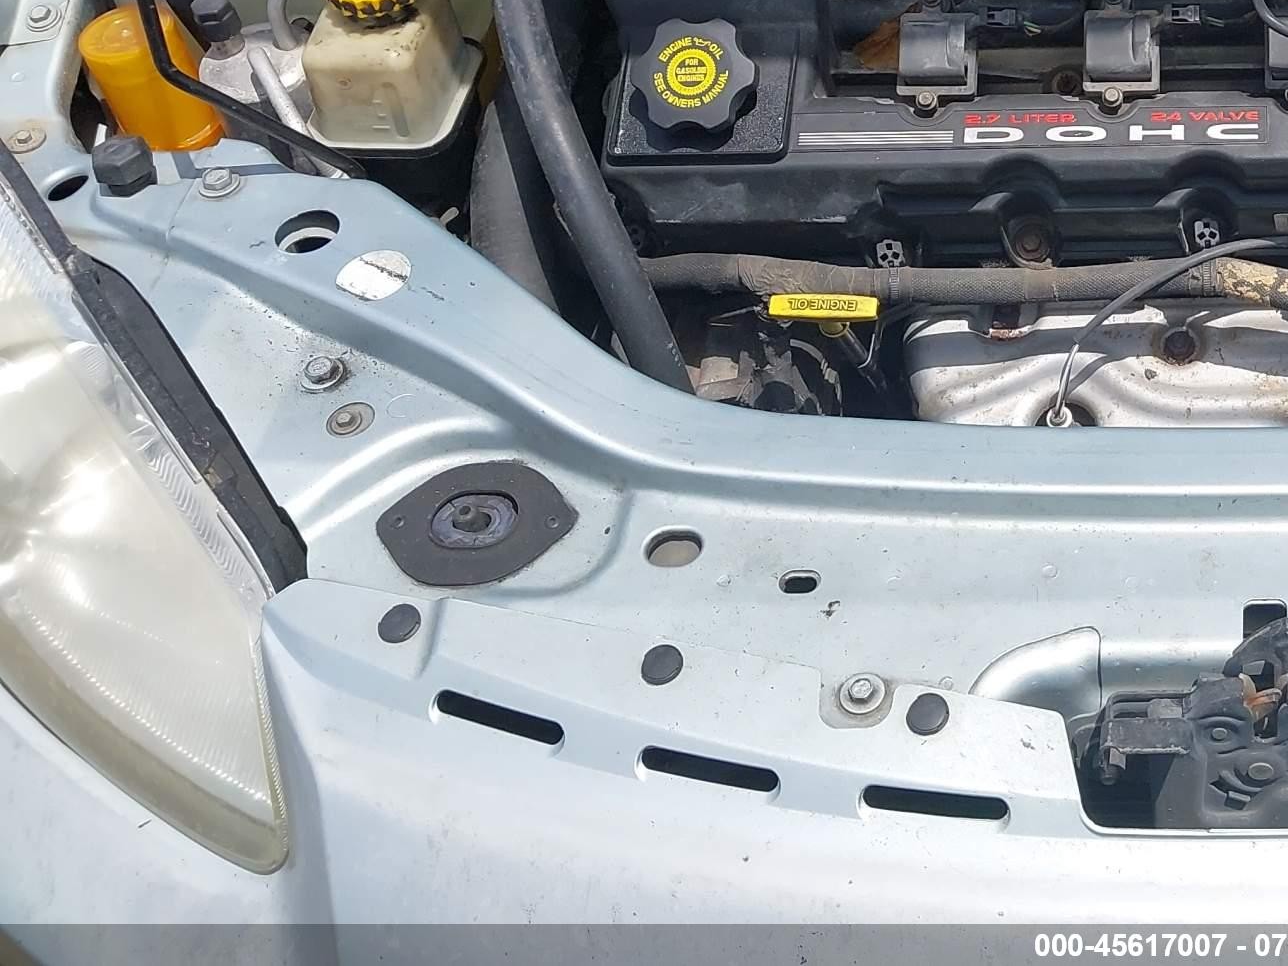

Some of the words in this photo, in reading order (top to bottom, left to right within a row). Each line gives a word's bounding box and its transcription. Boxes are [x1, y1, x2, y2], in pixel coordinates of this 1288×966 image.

[658, 37, 692, 62] ENGINE
[709, 44, 724, 60] OIL
[685, 58, 698, 66] FOR
[654, 72, 666, 92] SEE
[662, 90, 701, 108] OWNERS
[702, 70, 728, 104] MANUAL
[965, 114, 1001, 124] 2.7
[1008, 113, 1078, 123] LITER
[1151, 112, 1182, 122] 24
[1190, 110, 1260, 120] VALVE
[964, 123, 1259, 144] DOHC
[788, 298, 808, 310] OIL
[811, 299, 857, 311] ENGINE
